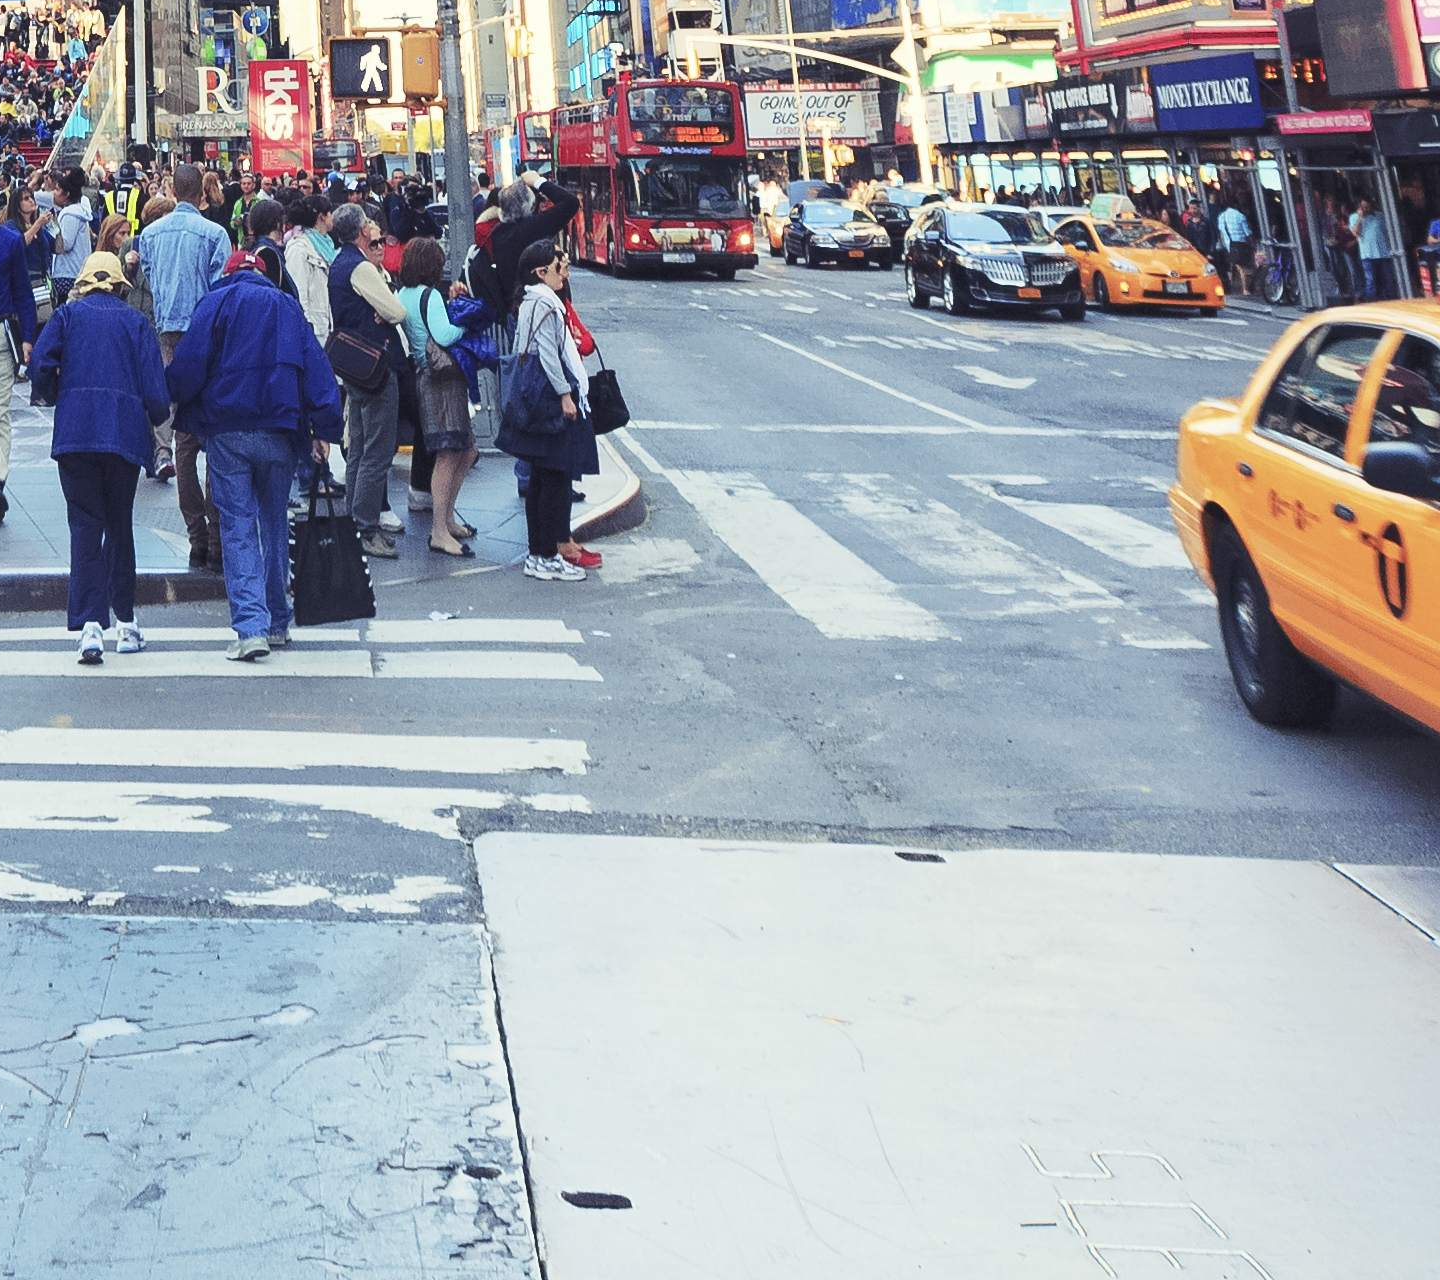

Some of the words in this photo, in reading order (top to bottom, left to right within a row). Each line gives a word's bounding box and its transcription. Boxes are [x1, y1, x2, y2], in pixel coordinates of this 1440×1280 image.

[264, 66, 298, 142] tkts
[806, 95, 833, 109] OUT
[835, 95, 855, 108] OF
